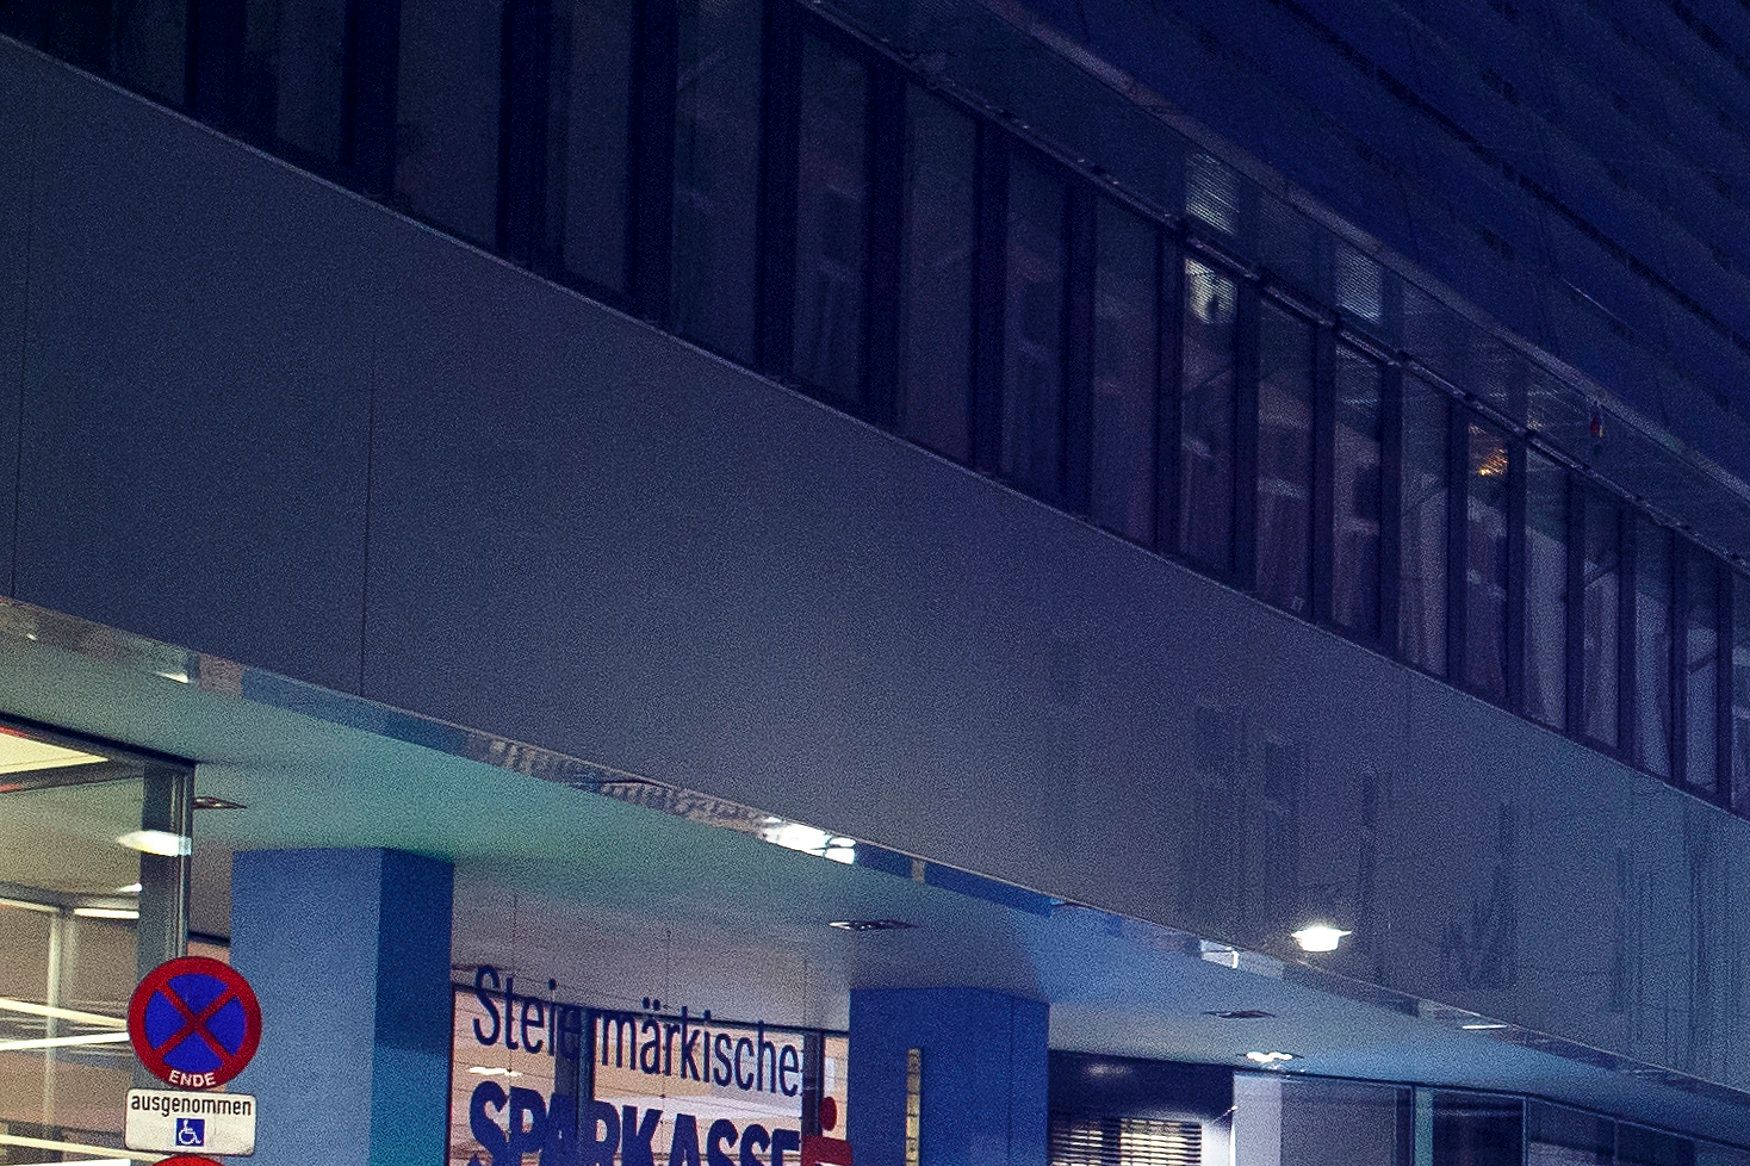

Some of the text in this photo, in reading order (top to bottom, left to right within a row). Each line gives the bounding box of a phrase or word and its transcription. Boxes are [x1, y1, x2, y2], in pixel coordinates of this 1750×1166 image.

[473, 965, 802, 1097] Steiemärkische
[168, 1069, 217, 1088] ENDE
[131, 1095, 252, 1117] ausgenommen
